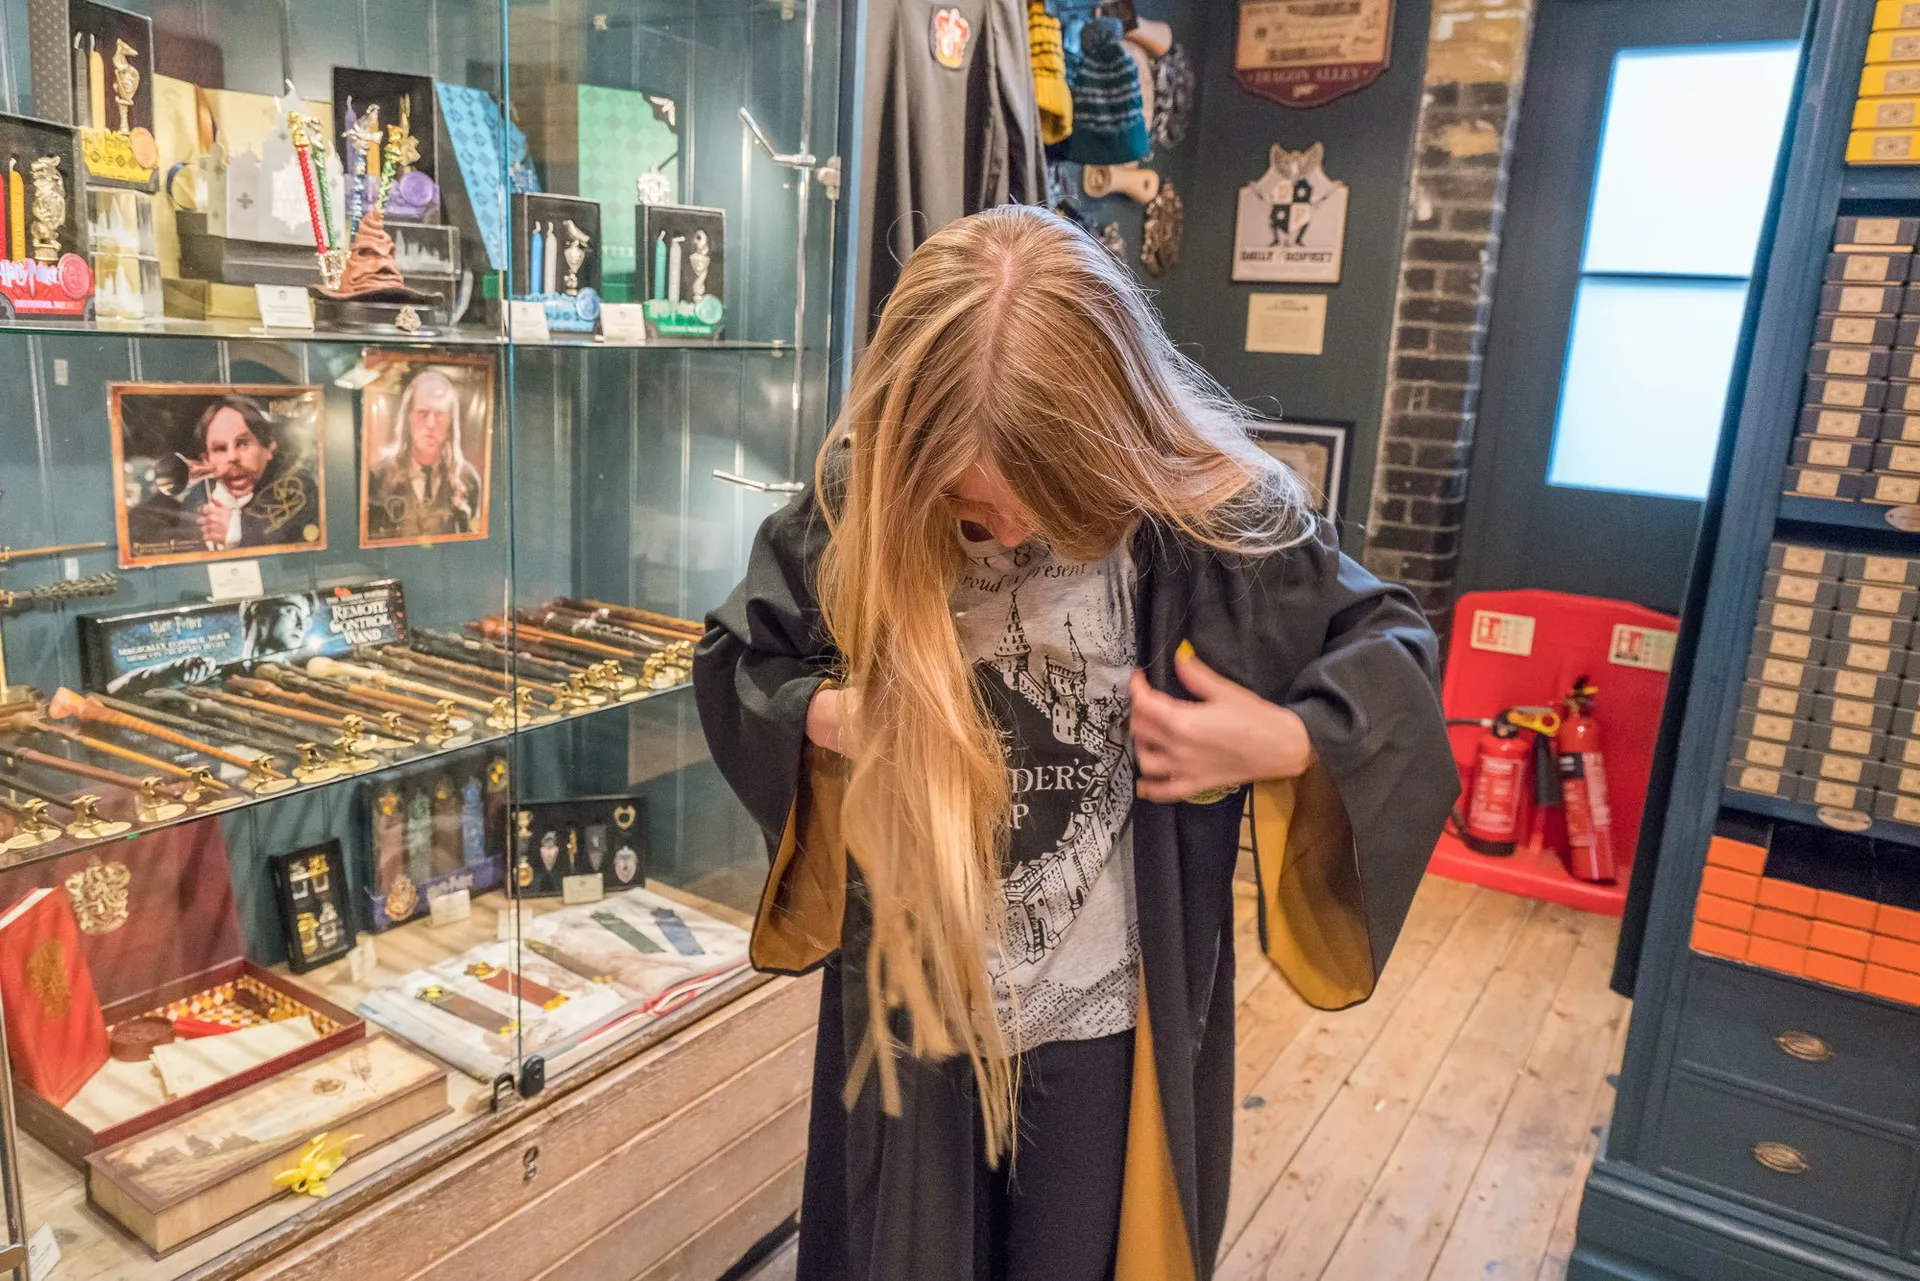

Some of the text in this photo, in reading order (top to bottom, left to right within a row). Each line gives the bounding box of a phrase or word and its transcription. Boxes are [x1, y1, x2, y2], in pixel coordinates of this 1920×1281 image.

[962, 575, 1009, 593] roud
[332, 600, 389, 622] REMOTE
[329, 613, 392, 633] CONTROL
[343, 628, 382, 644] WAND
[1009, 758, 1094, 794] DER'S
